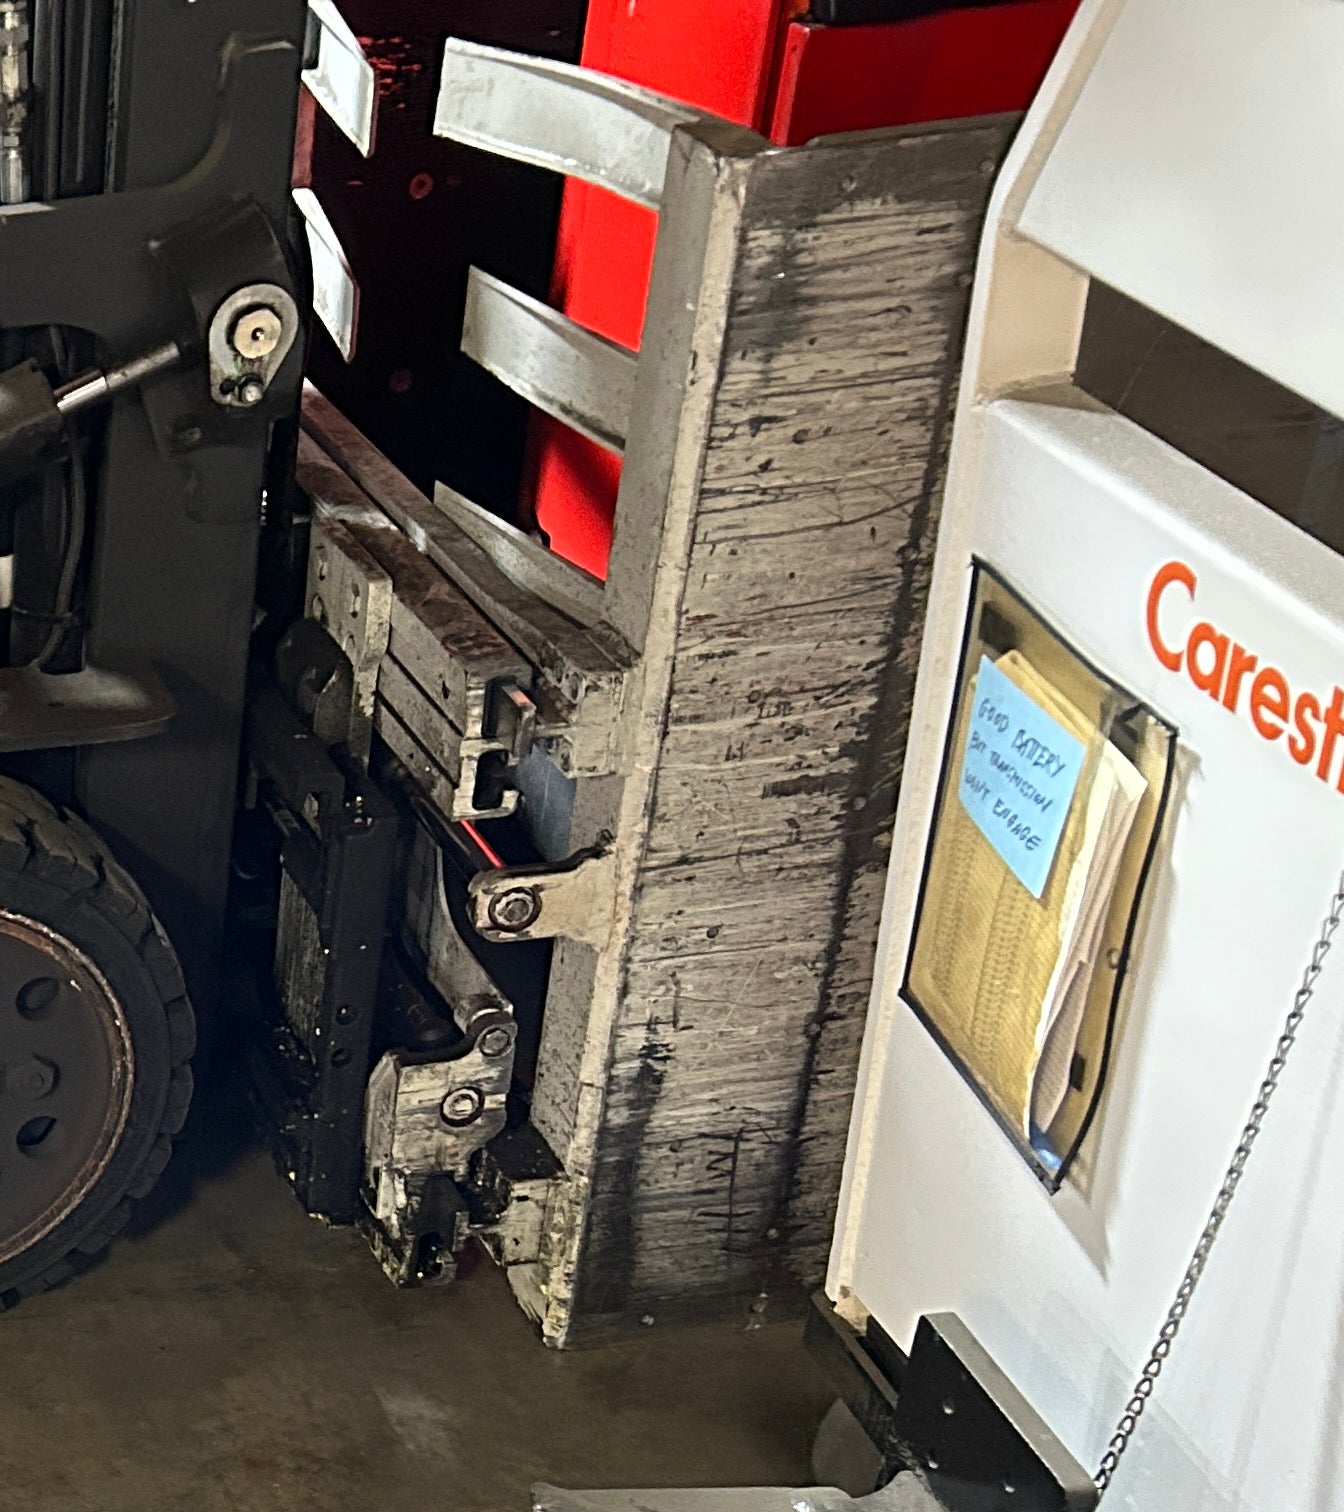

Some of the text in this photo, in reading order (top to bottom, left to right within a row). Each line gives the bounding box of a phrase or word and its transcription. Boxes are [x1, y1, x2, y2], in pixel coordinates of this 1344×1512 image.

[1146, 560, 1344, 797] Carest
[978, 698, 1067, 778] GOOD BATTERY
[992, 797, 1043, 851] ENGAGE
